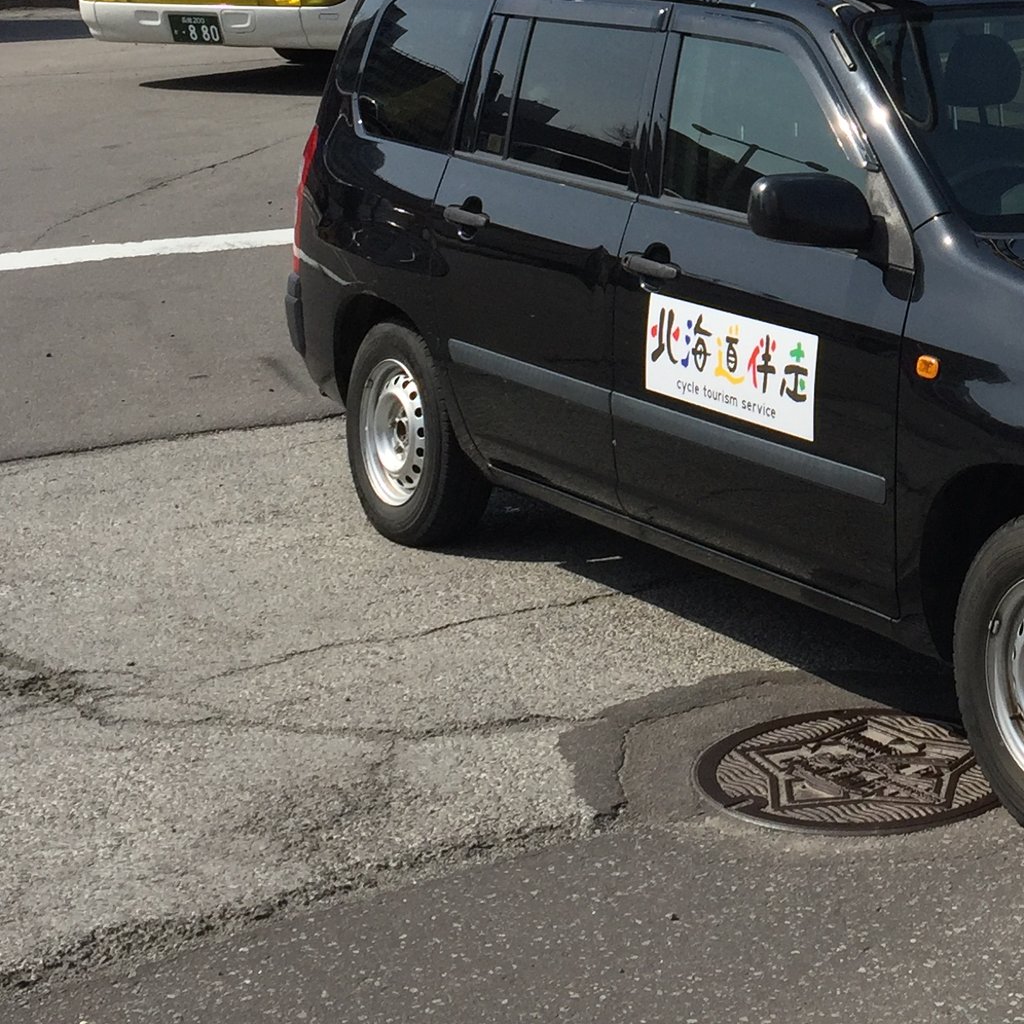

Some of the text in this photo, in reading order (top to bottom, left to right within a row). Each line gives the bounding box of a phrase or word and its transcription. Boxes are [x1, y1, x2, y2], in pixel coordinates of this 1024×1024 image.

[676, 379, 776, 418] cycle tourism service
